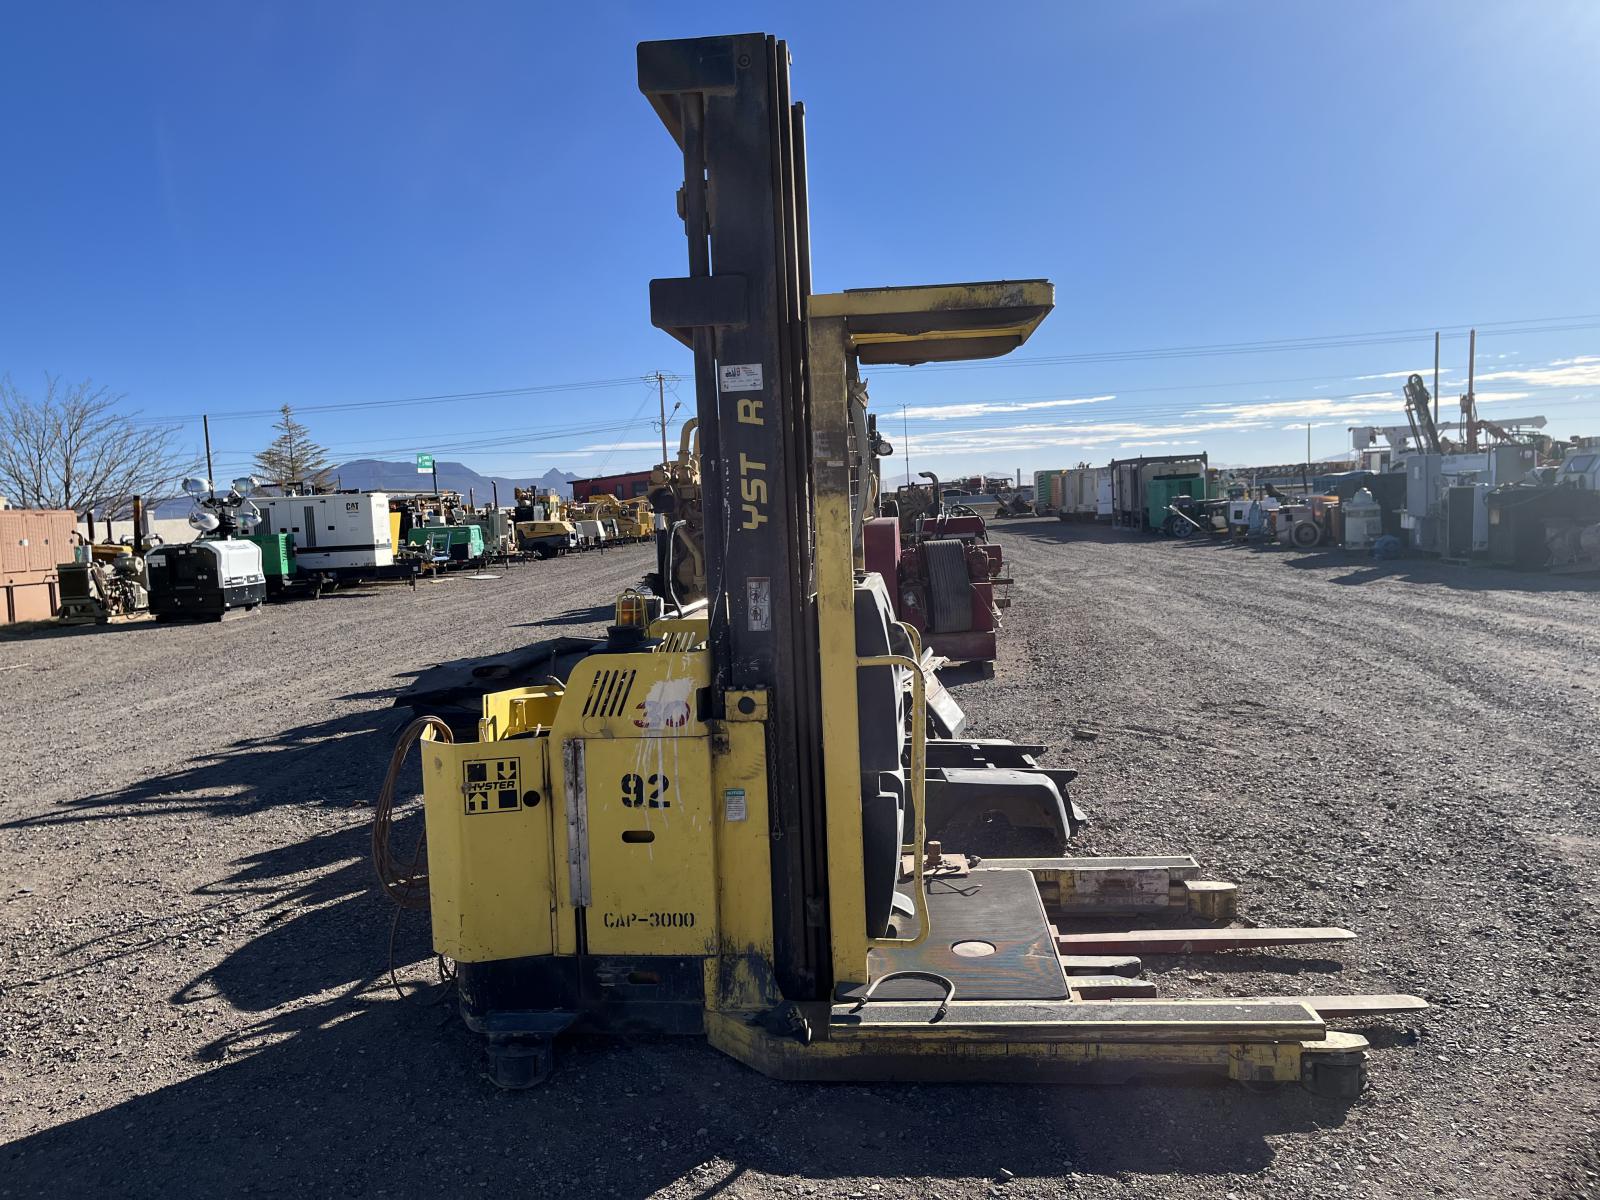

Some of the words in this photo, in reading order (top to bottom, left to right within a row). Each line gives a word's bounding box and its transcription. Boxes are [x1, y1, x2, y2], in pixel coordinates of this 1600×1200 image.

[346, 502, 358, 510] CAT
[621, 773, 670, 808] 92
[604, 912, 695, 928] CAP-3000
